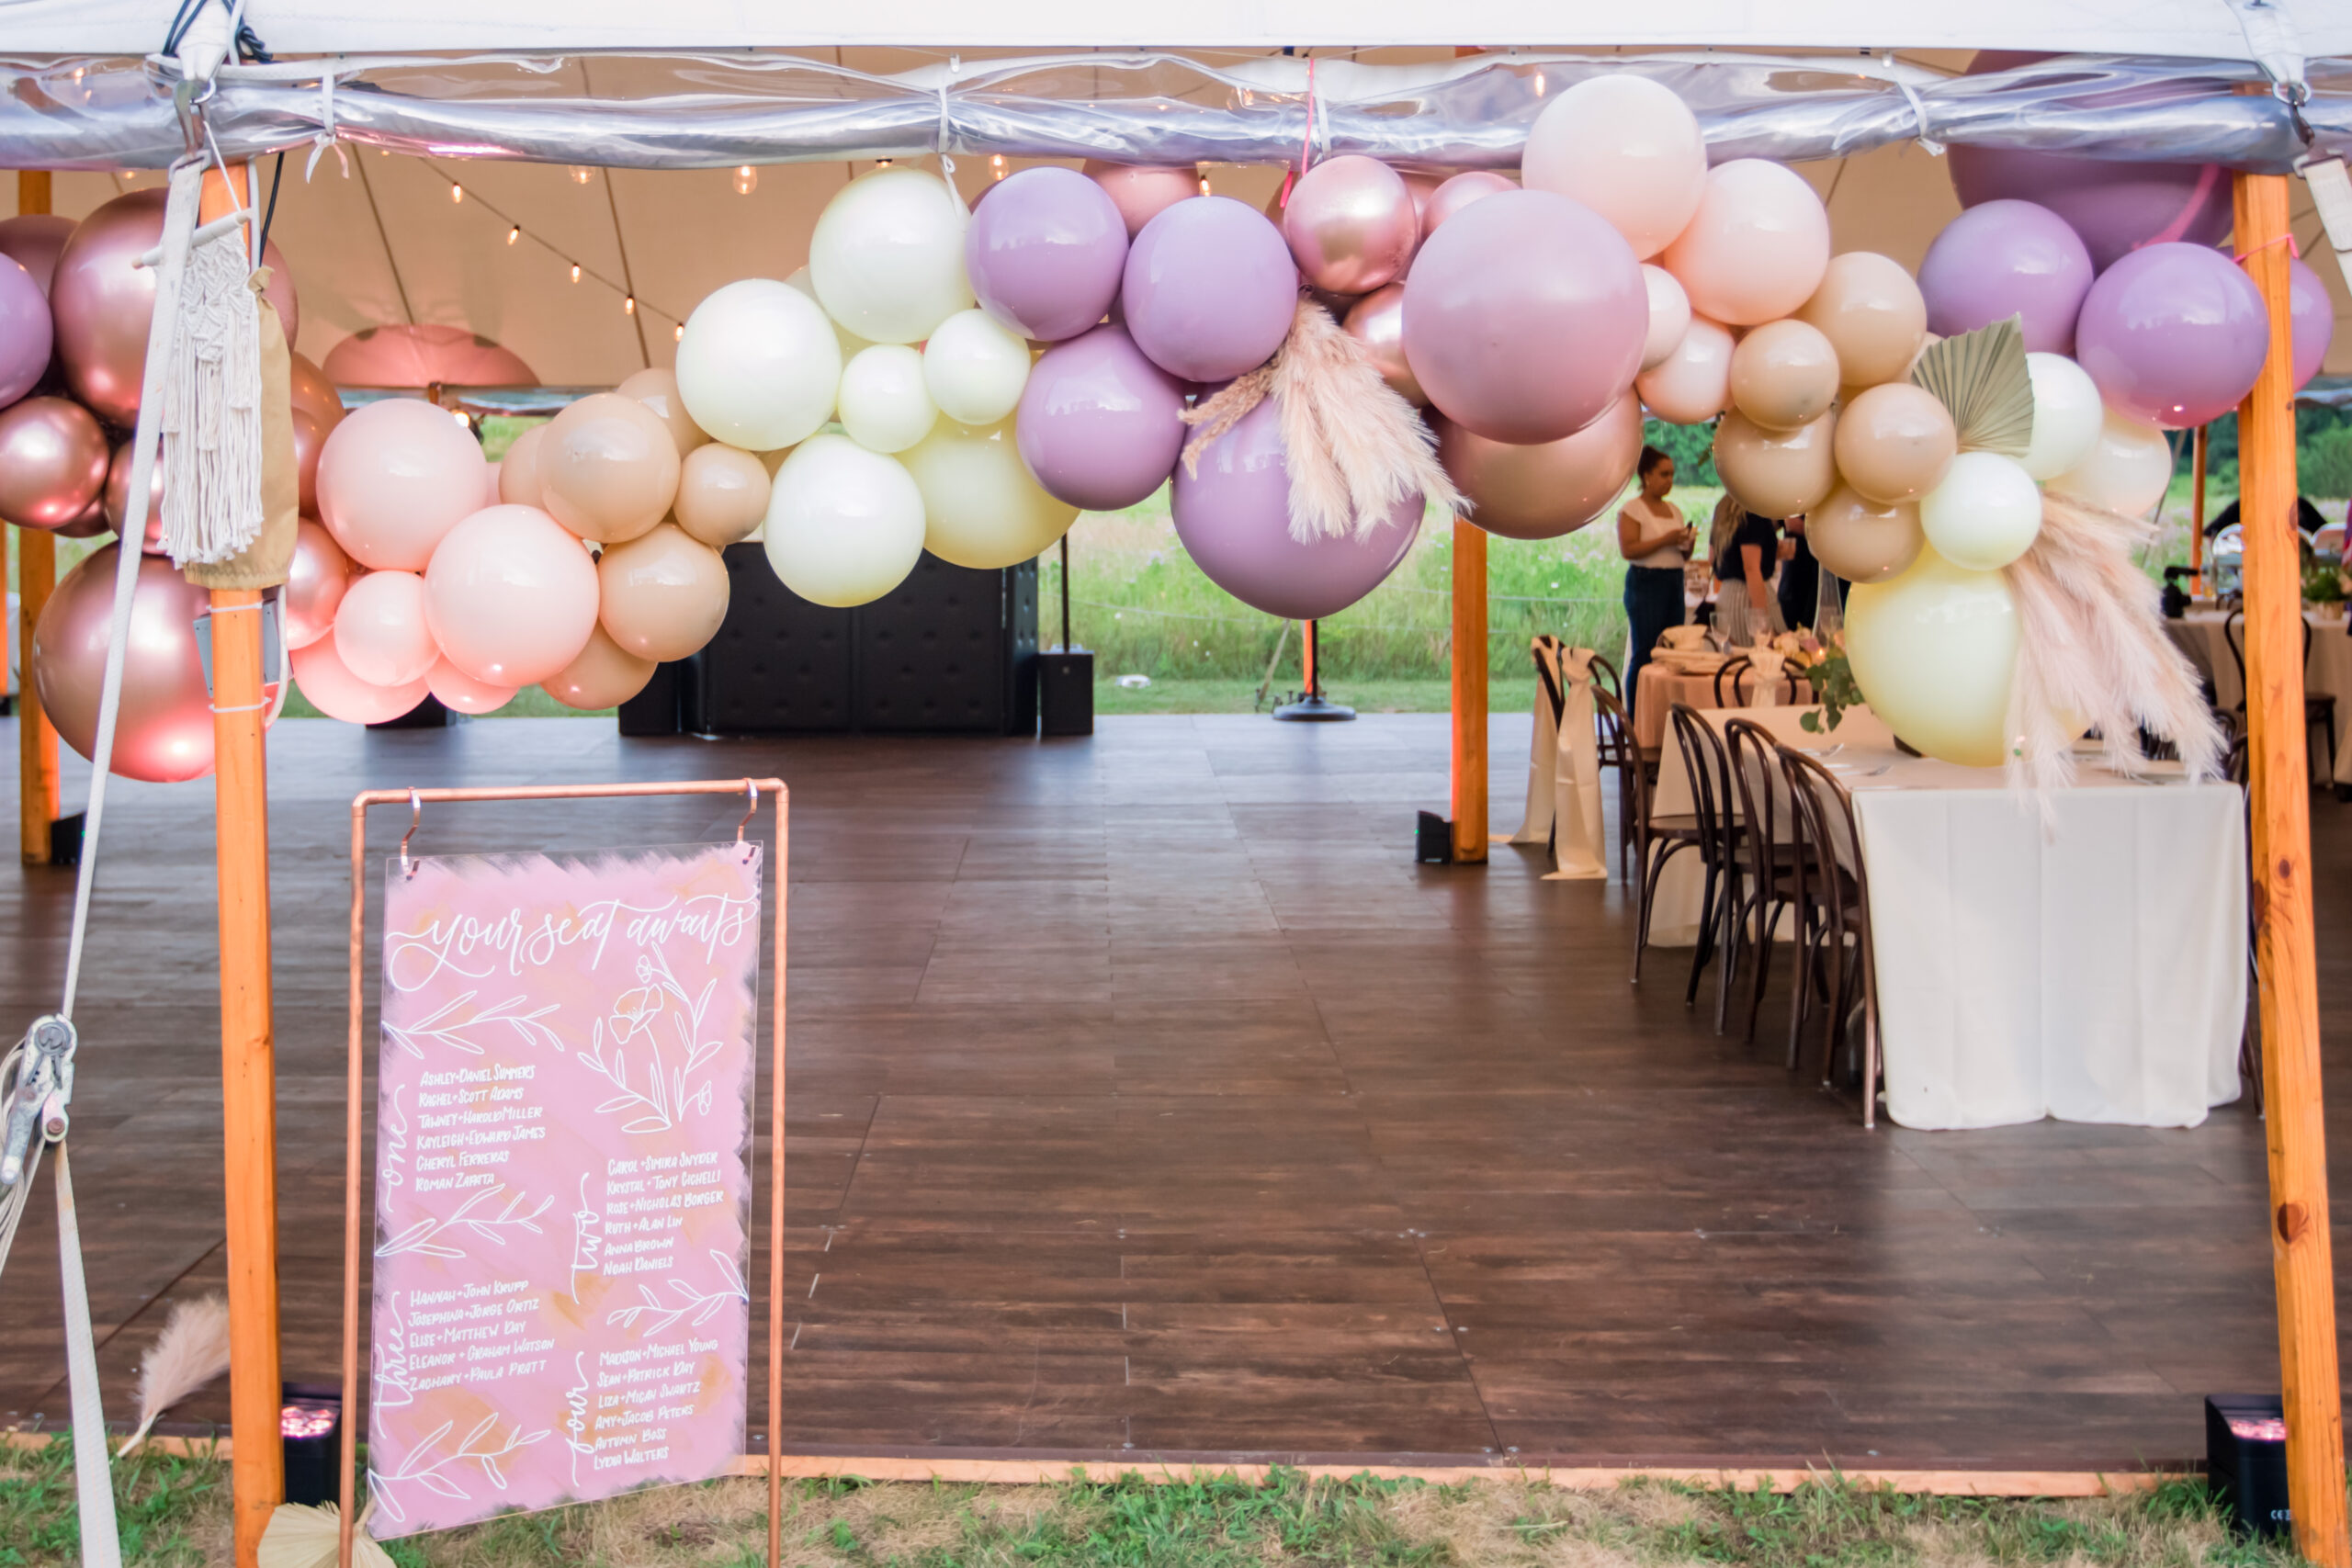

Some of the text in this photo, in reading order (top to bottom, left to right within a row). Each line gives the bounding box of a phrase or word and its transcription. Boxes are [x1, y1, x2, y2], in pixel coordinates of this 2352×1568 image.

[385, 886, 760, 992] your seat awaits
[493, 1064, 536, 1080] SUMMERS
[490, 1086, 524, 1100] ADAMS
[502, 1106, 543, 1121] MILLER
[513, 1125, 546, 1140] JAMES
[382, 1084, 408, 1213] one
[416, 1156, 456, 1171] CHERYL
[680, 1152, 718, 1168] SNYDER
[415, 1173, 494, 1191] ROMAN ZAPATA
[682, 1169, 721, 1187] CICHELLI
[684, 1191, 724, 1208] BORGER
[668, 1215, 683, 1228] LIN
[571, 1172, 603, 1304] two
[605, 1237, 673, 1257] ANNA BROWN
[604, 1256, 673, 1276] NOAH DANIELS
[493, 1280, 529, 1295] KRUPP
[506, 1298, 539, 1314] ORTIZ
[504, 1321, 526, 1335] DAY
[514, 1337, 555, 1355] WATSON
[689, 1337, 718, 1352] YOUNG
[374, 1291, 413, 1439] three
[509, 1359, 547, 1376] PRATT
[673, 1361, 695, 1376] DAY
[625, 1390, 656, 1404] MICAH
[565, 1351, 595, 1487] four
[658, 1404, 695, 1419] PETERS
[595, 1428, 667, 1451] AUTUMN BOSS
[594, 1447, 669, 1470] LYDIA WALTERS
